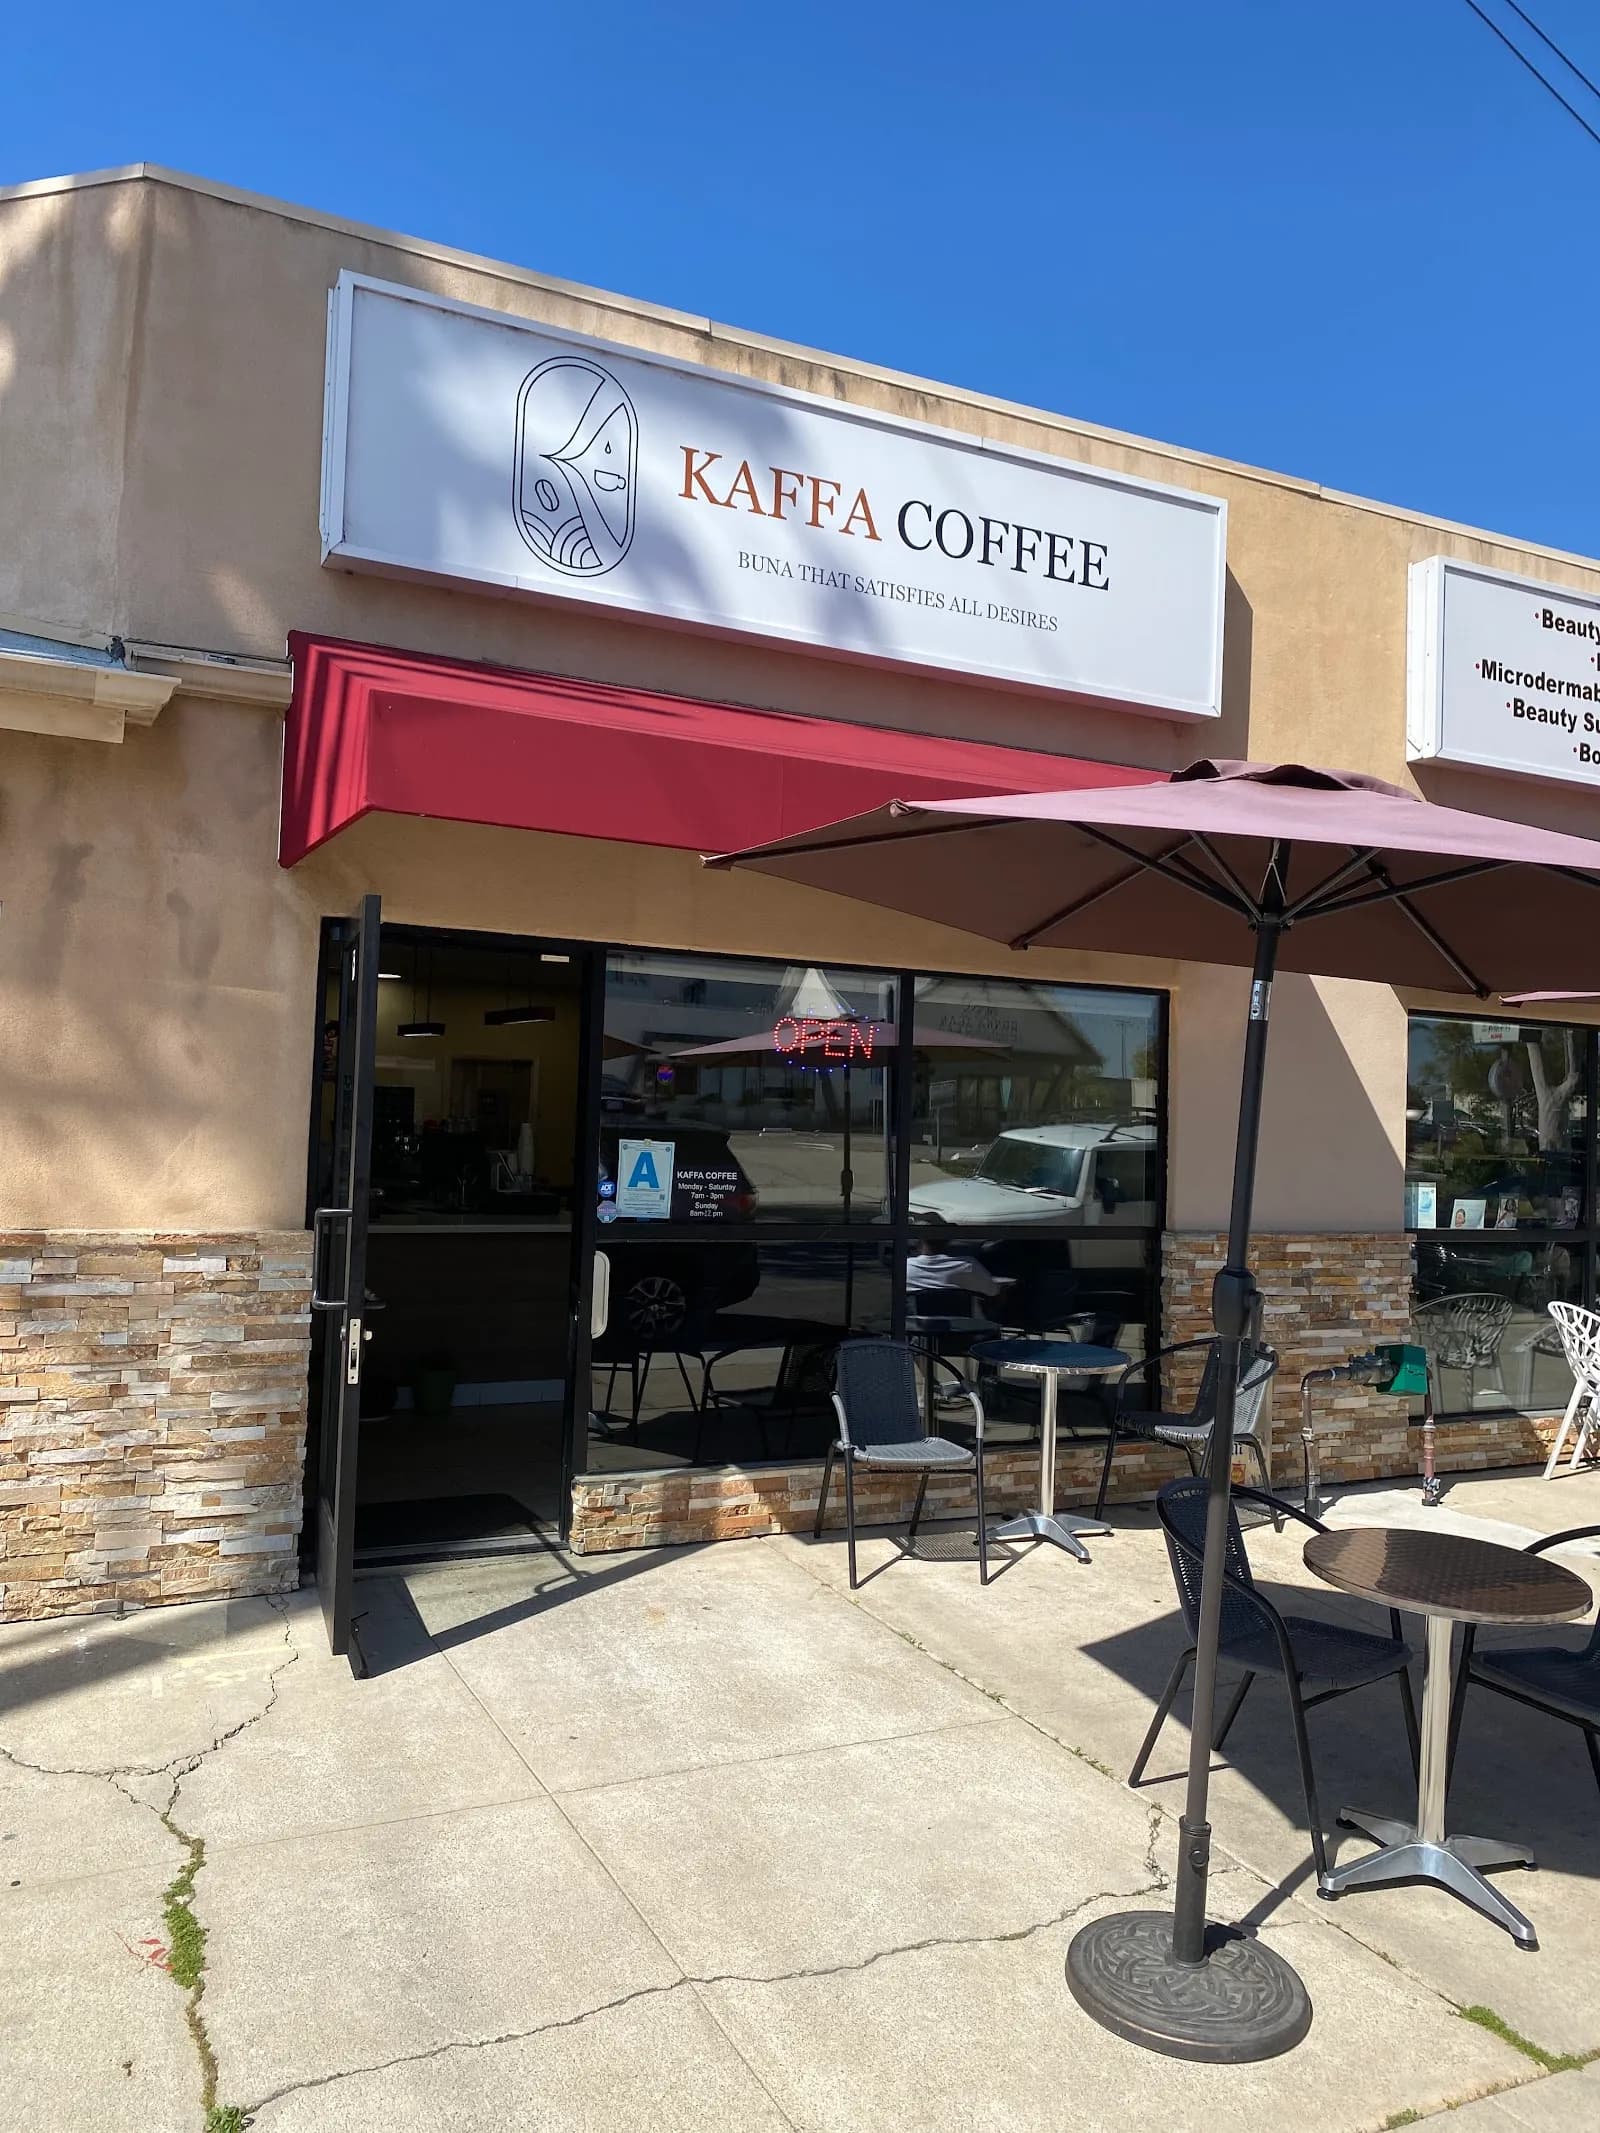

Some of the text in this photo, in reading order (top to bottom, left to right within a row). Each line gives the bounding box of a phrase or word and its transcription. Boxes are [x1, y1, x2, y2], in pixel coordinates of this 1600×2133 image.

[678, 445, 1110, 591] KAFFA COFFEE
[738, 551, 1059, 632] BUNA THAT SATISFIES ALL DESIRES
[1513, 697, 1578, 733] Beauty
[773, 1017, 874, 1059] OPEN
[627, 1152, 660, 1188] A
[677, 1171, 738, 1181] KAFFA COFFEE
[678, 1182, 703, 1191] Monday
[708, 1183, 737, 1192] Saturday
[690, 1191, 705, 1199] 7am
[694, 1201, 719, 1211] Sunday
